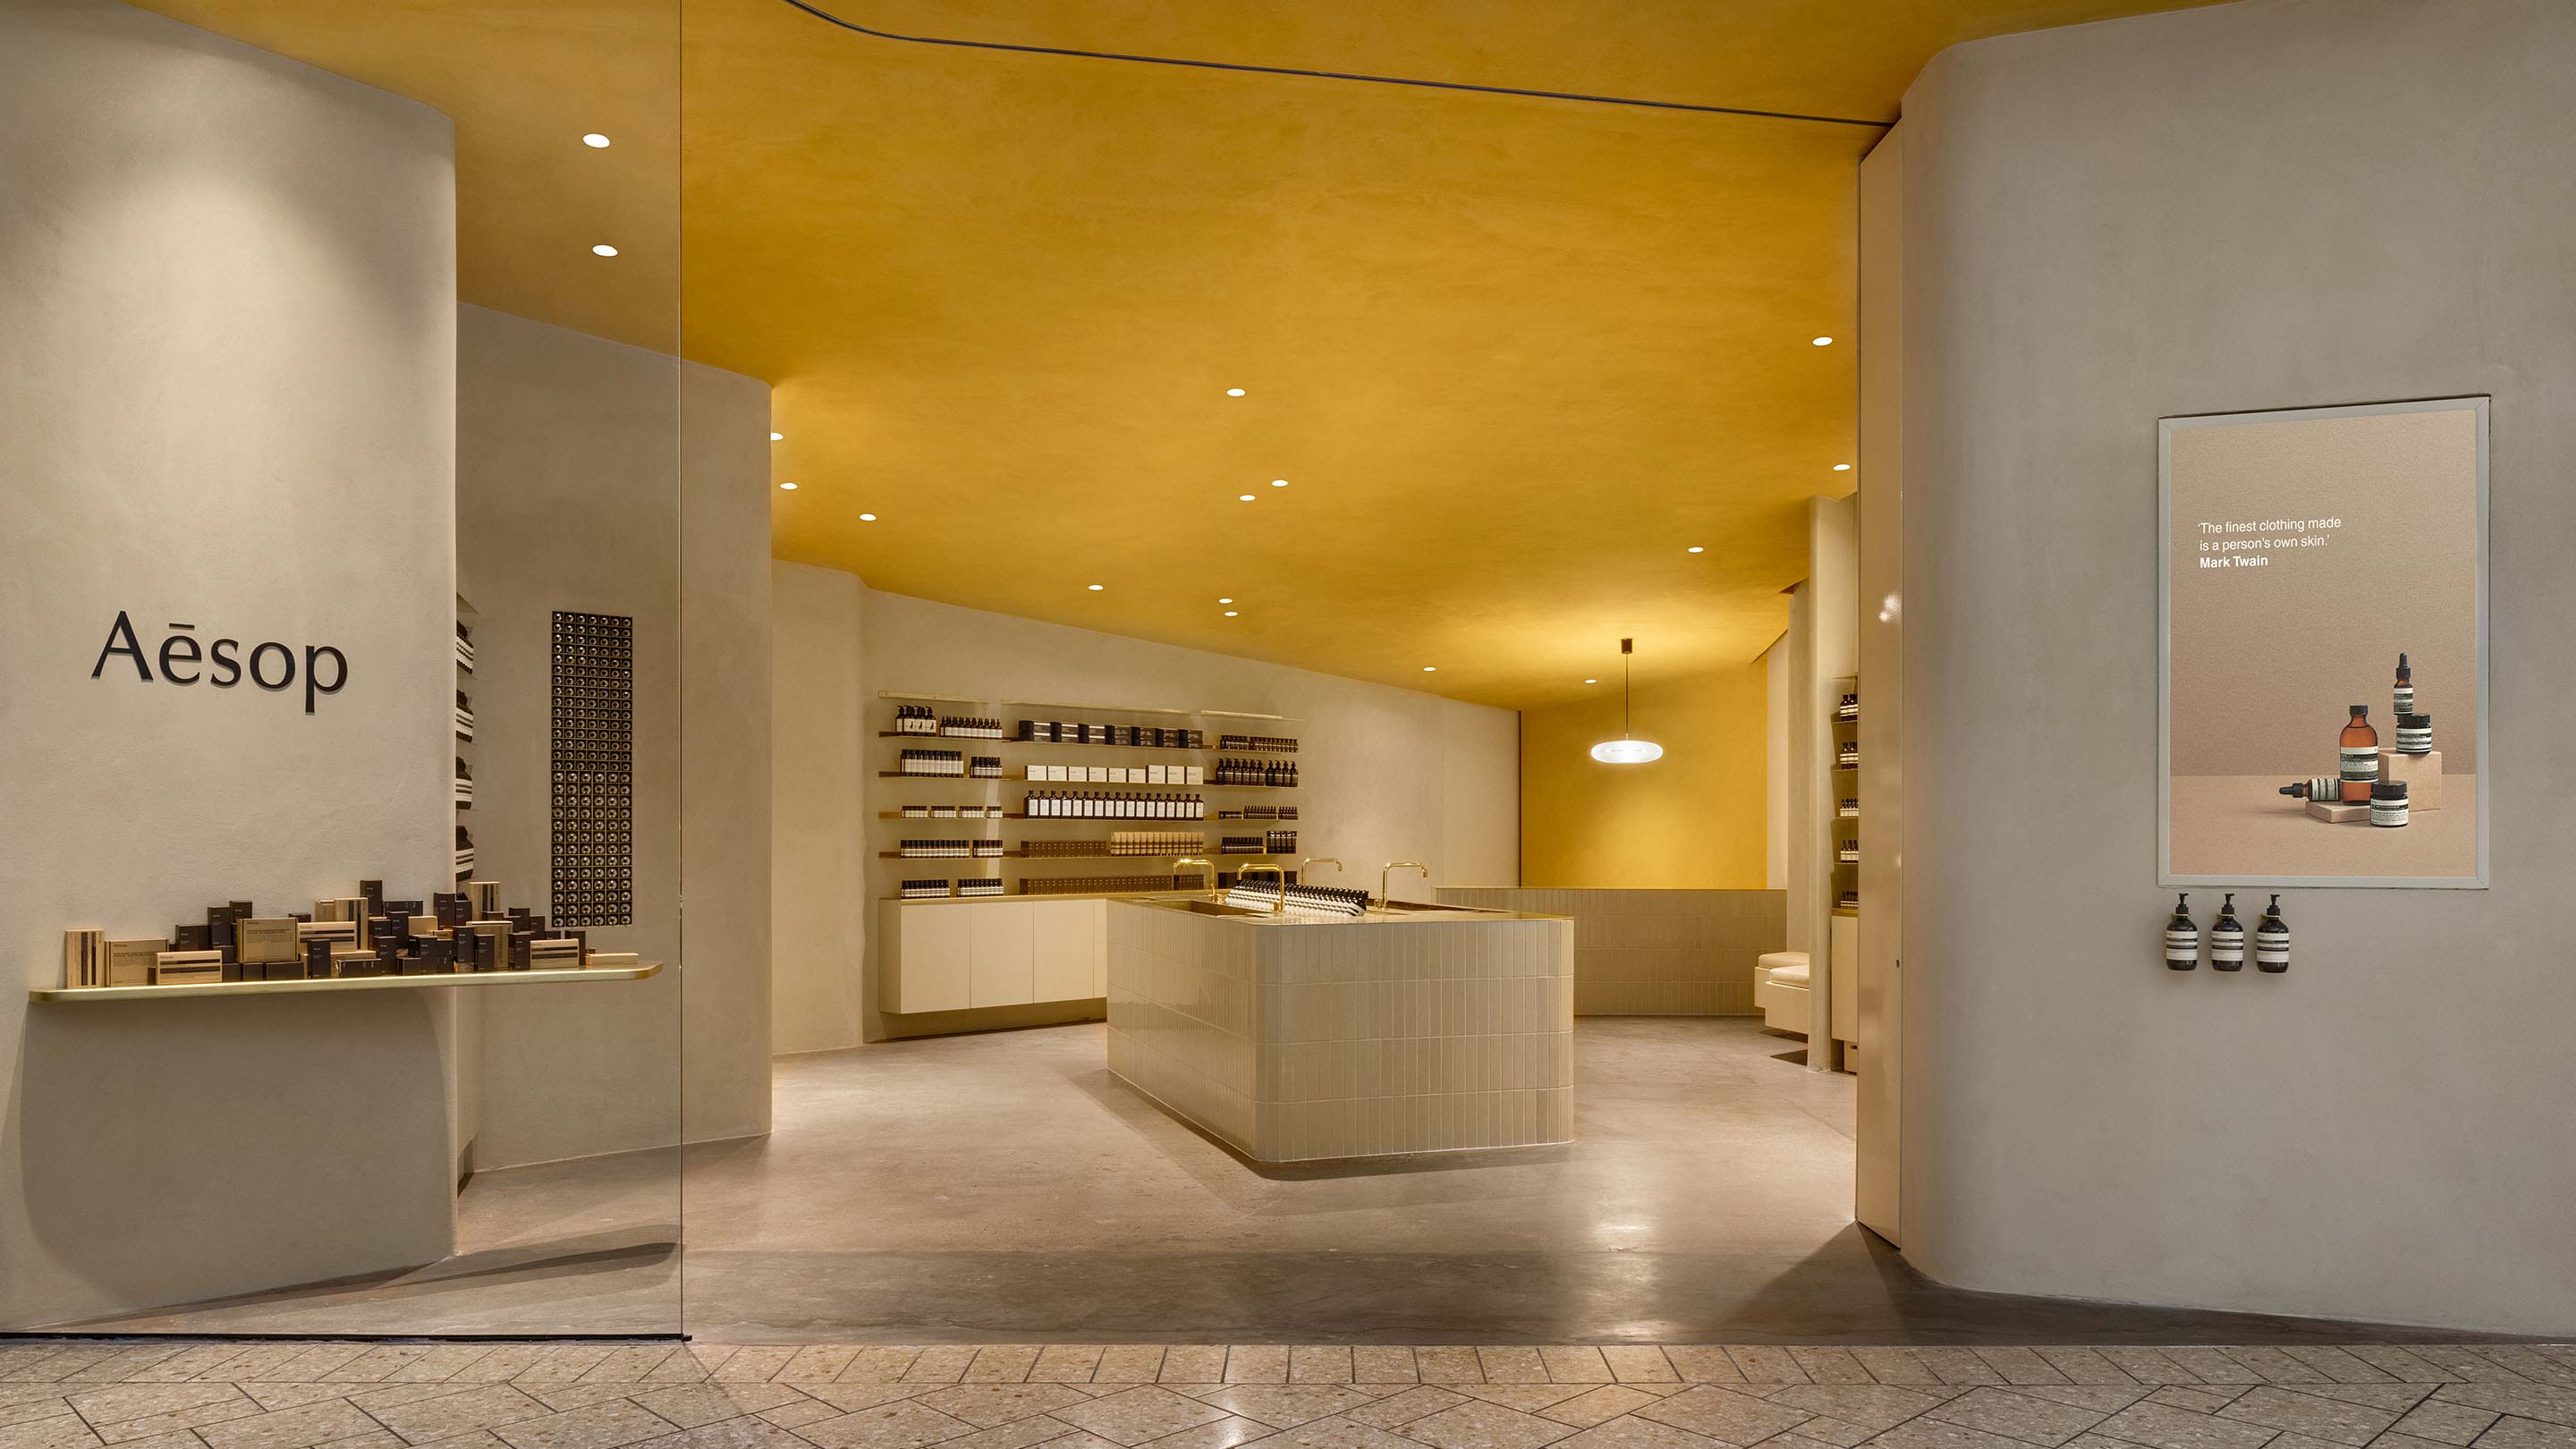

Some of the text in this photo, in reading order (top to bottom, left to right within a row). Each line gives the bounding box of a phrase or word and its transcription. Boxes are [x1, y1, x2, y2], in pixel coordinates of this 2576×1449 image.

[2198, 517, 2342, 534] ‘The finest clothing made
[2199, 539, 2209, 551] is
[2212, 542, 2219, 551] a
[2222, 538, 2271, 553] person’s
[2274, 538, 2298, 547] own
[2199, 555, 2268, 569] Mark Twain
[91, 610, 348, 716] Aēsop
